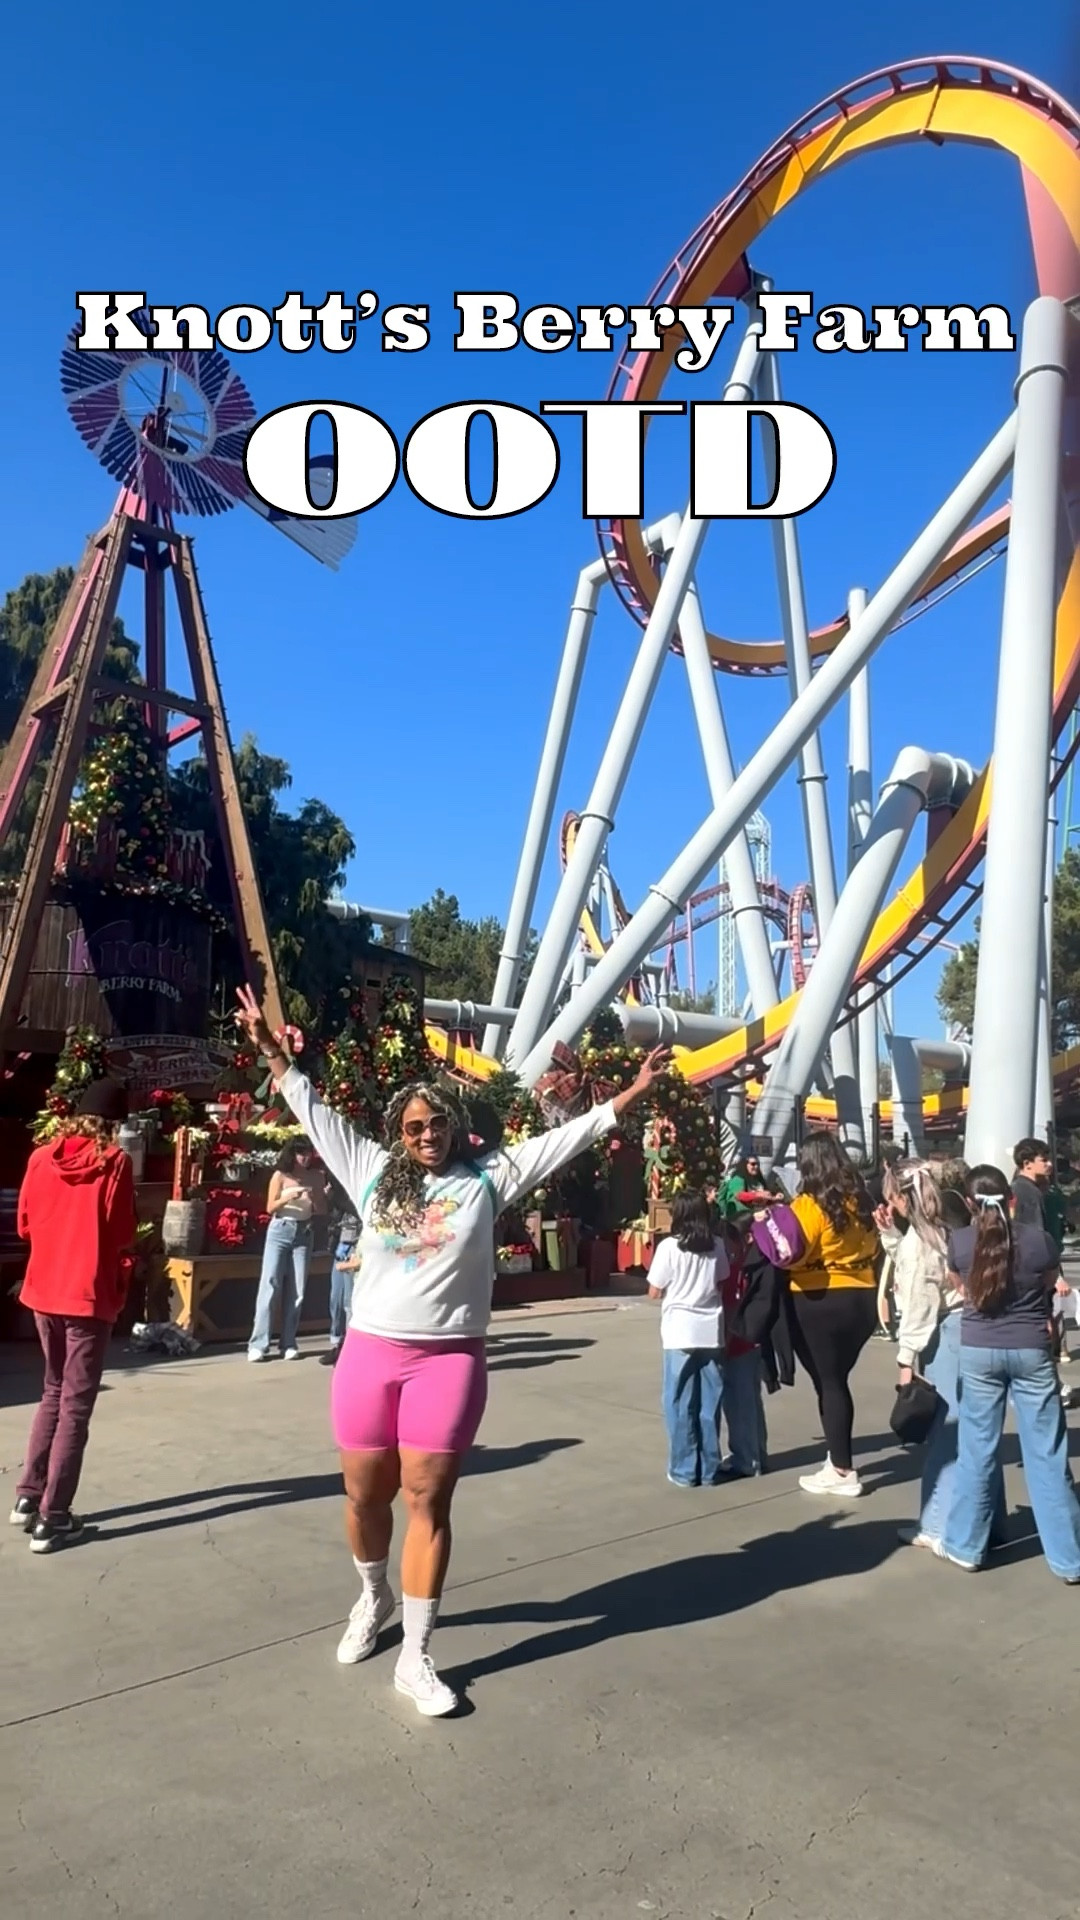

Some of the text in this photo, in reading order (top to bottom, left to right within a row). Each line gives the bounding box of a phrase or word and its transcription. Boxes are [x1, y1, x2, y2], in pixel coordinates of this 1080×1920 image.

[100, 976, 181, 1002] BERRY FARM
[141, 1053, 205, 1073] MERRY
